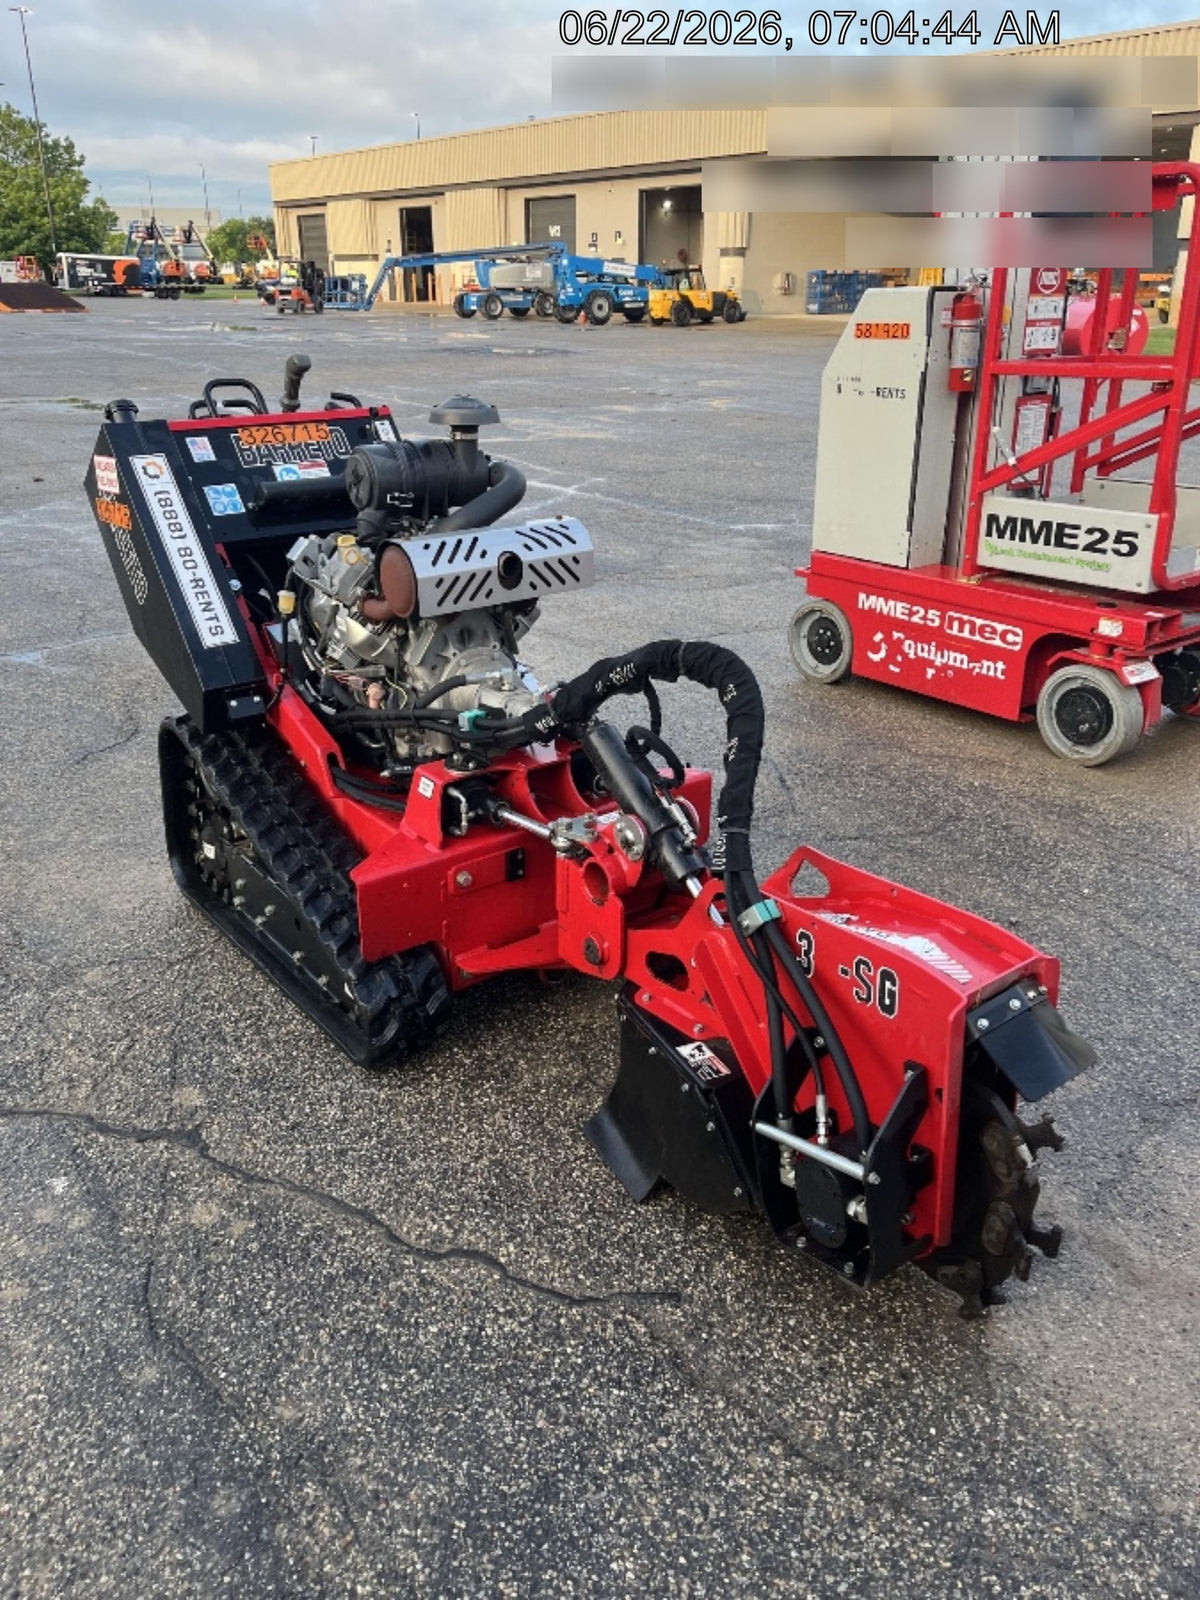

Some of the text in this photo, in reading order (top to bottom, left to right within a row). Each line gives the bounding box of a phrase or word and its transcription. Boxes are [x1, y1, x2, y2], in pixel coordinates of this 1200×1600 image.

[241, 422, 330, 445] 326715
[985, 513, 1139, 558] MME25
[154, 486, 226, 638] (888) 80-RENTS
[857, 592, 1023, 650] MME25 mec
